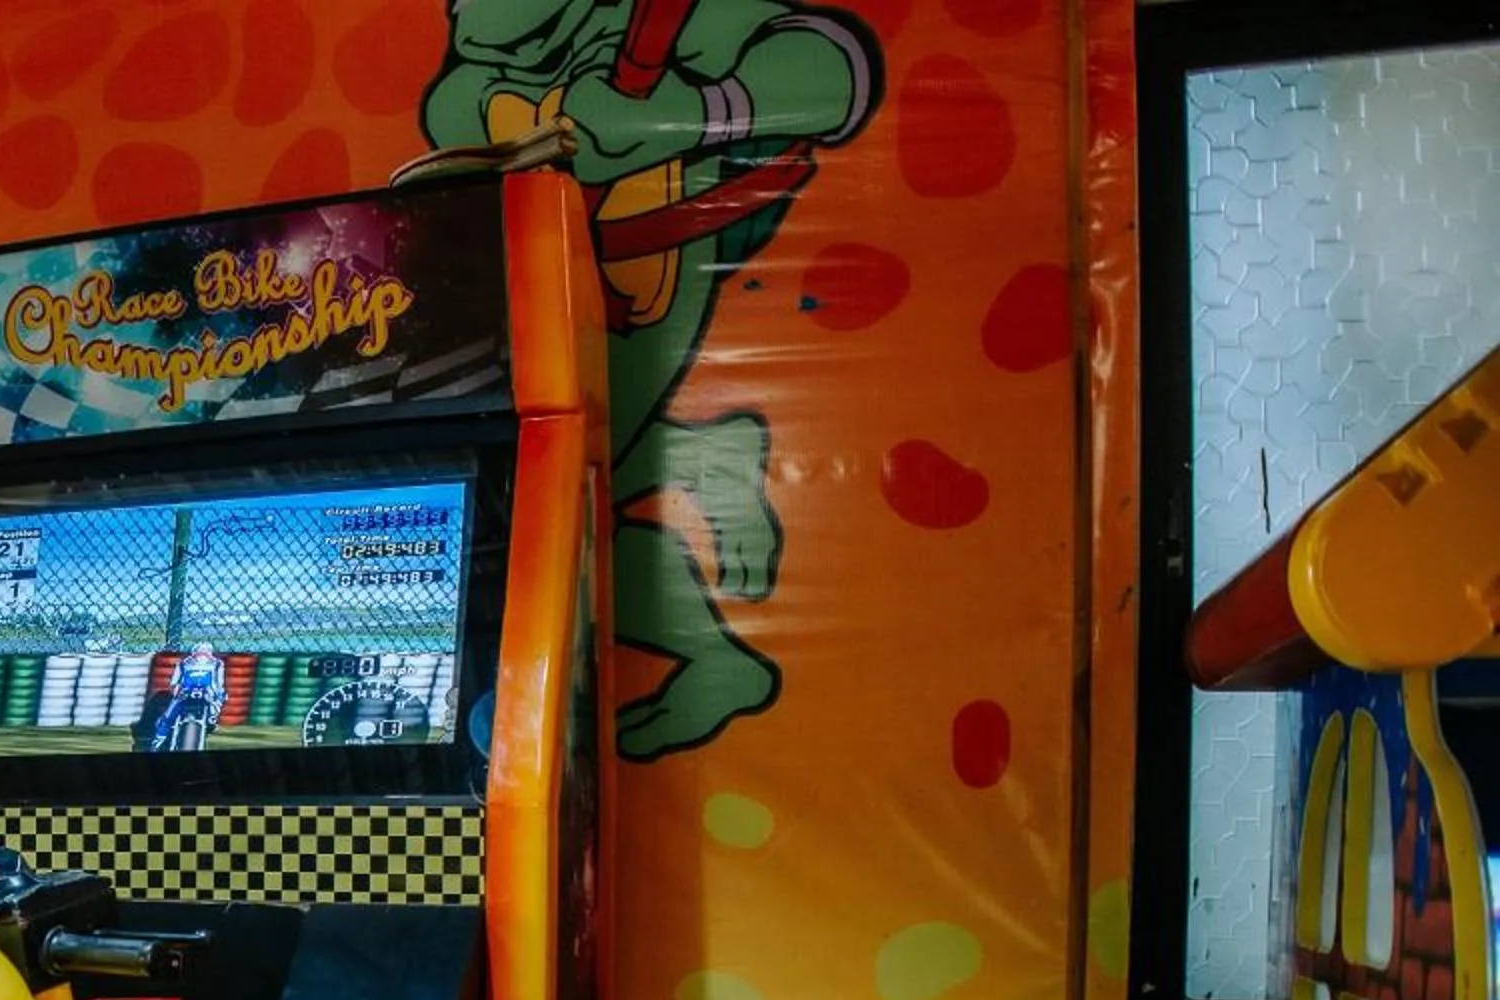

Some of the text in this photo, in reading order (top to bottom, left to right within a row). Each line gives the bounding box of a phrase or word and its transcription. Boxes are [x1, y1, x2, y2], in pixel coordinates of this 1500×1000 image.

[73, 248, 309, 328] Race Bike
[3, 258, 414, 413] Championship
[373, 503, 422, 514] Record
[10, 582, 19, 599] 1
